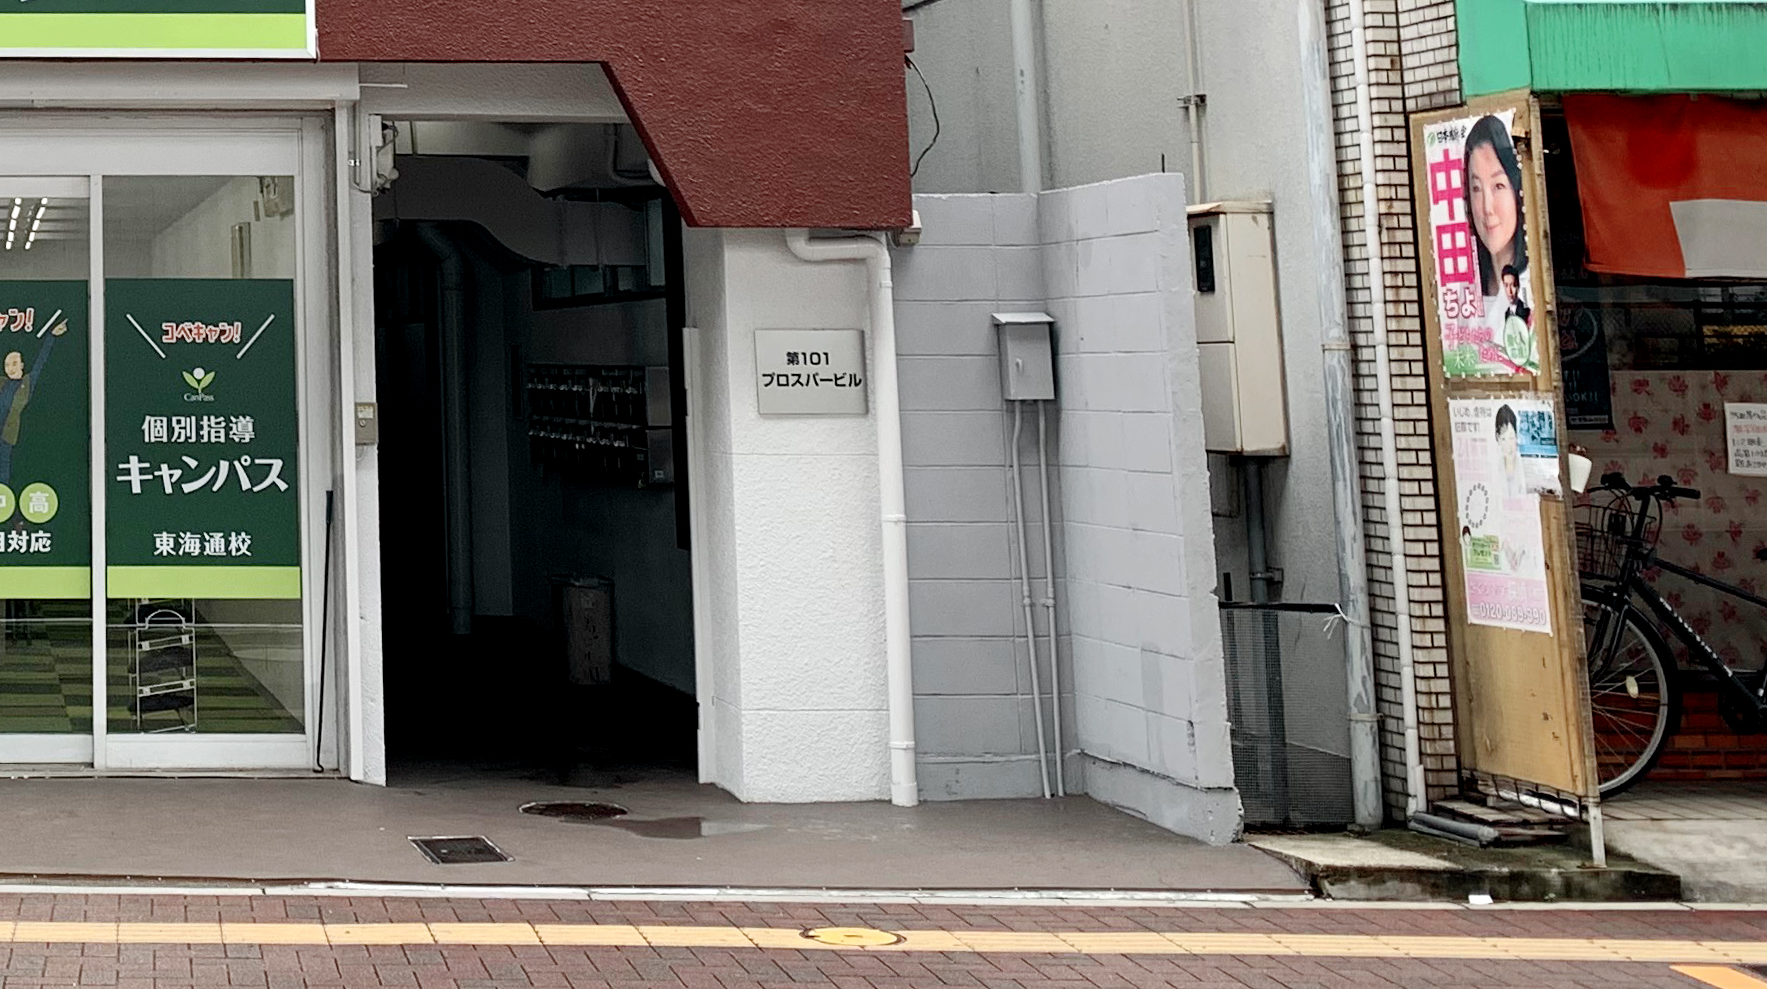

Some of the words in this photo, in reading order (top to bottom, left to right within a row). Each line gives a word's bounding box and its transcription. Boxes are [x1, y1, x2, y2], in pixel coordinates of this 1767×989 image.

[1429, 148, 1475, 287] 中田
[786, 351, 830, 366] 第101
[183, 392, 215, 402] CanPass
[141, 415, 256, 444] 個別指導
[116, 455, 290, 495] キャンパス
[153, 532, 253, 558] 東海通校
